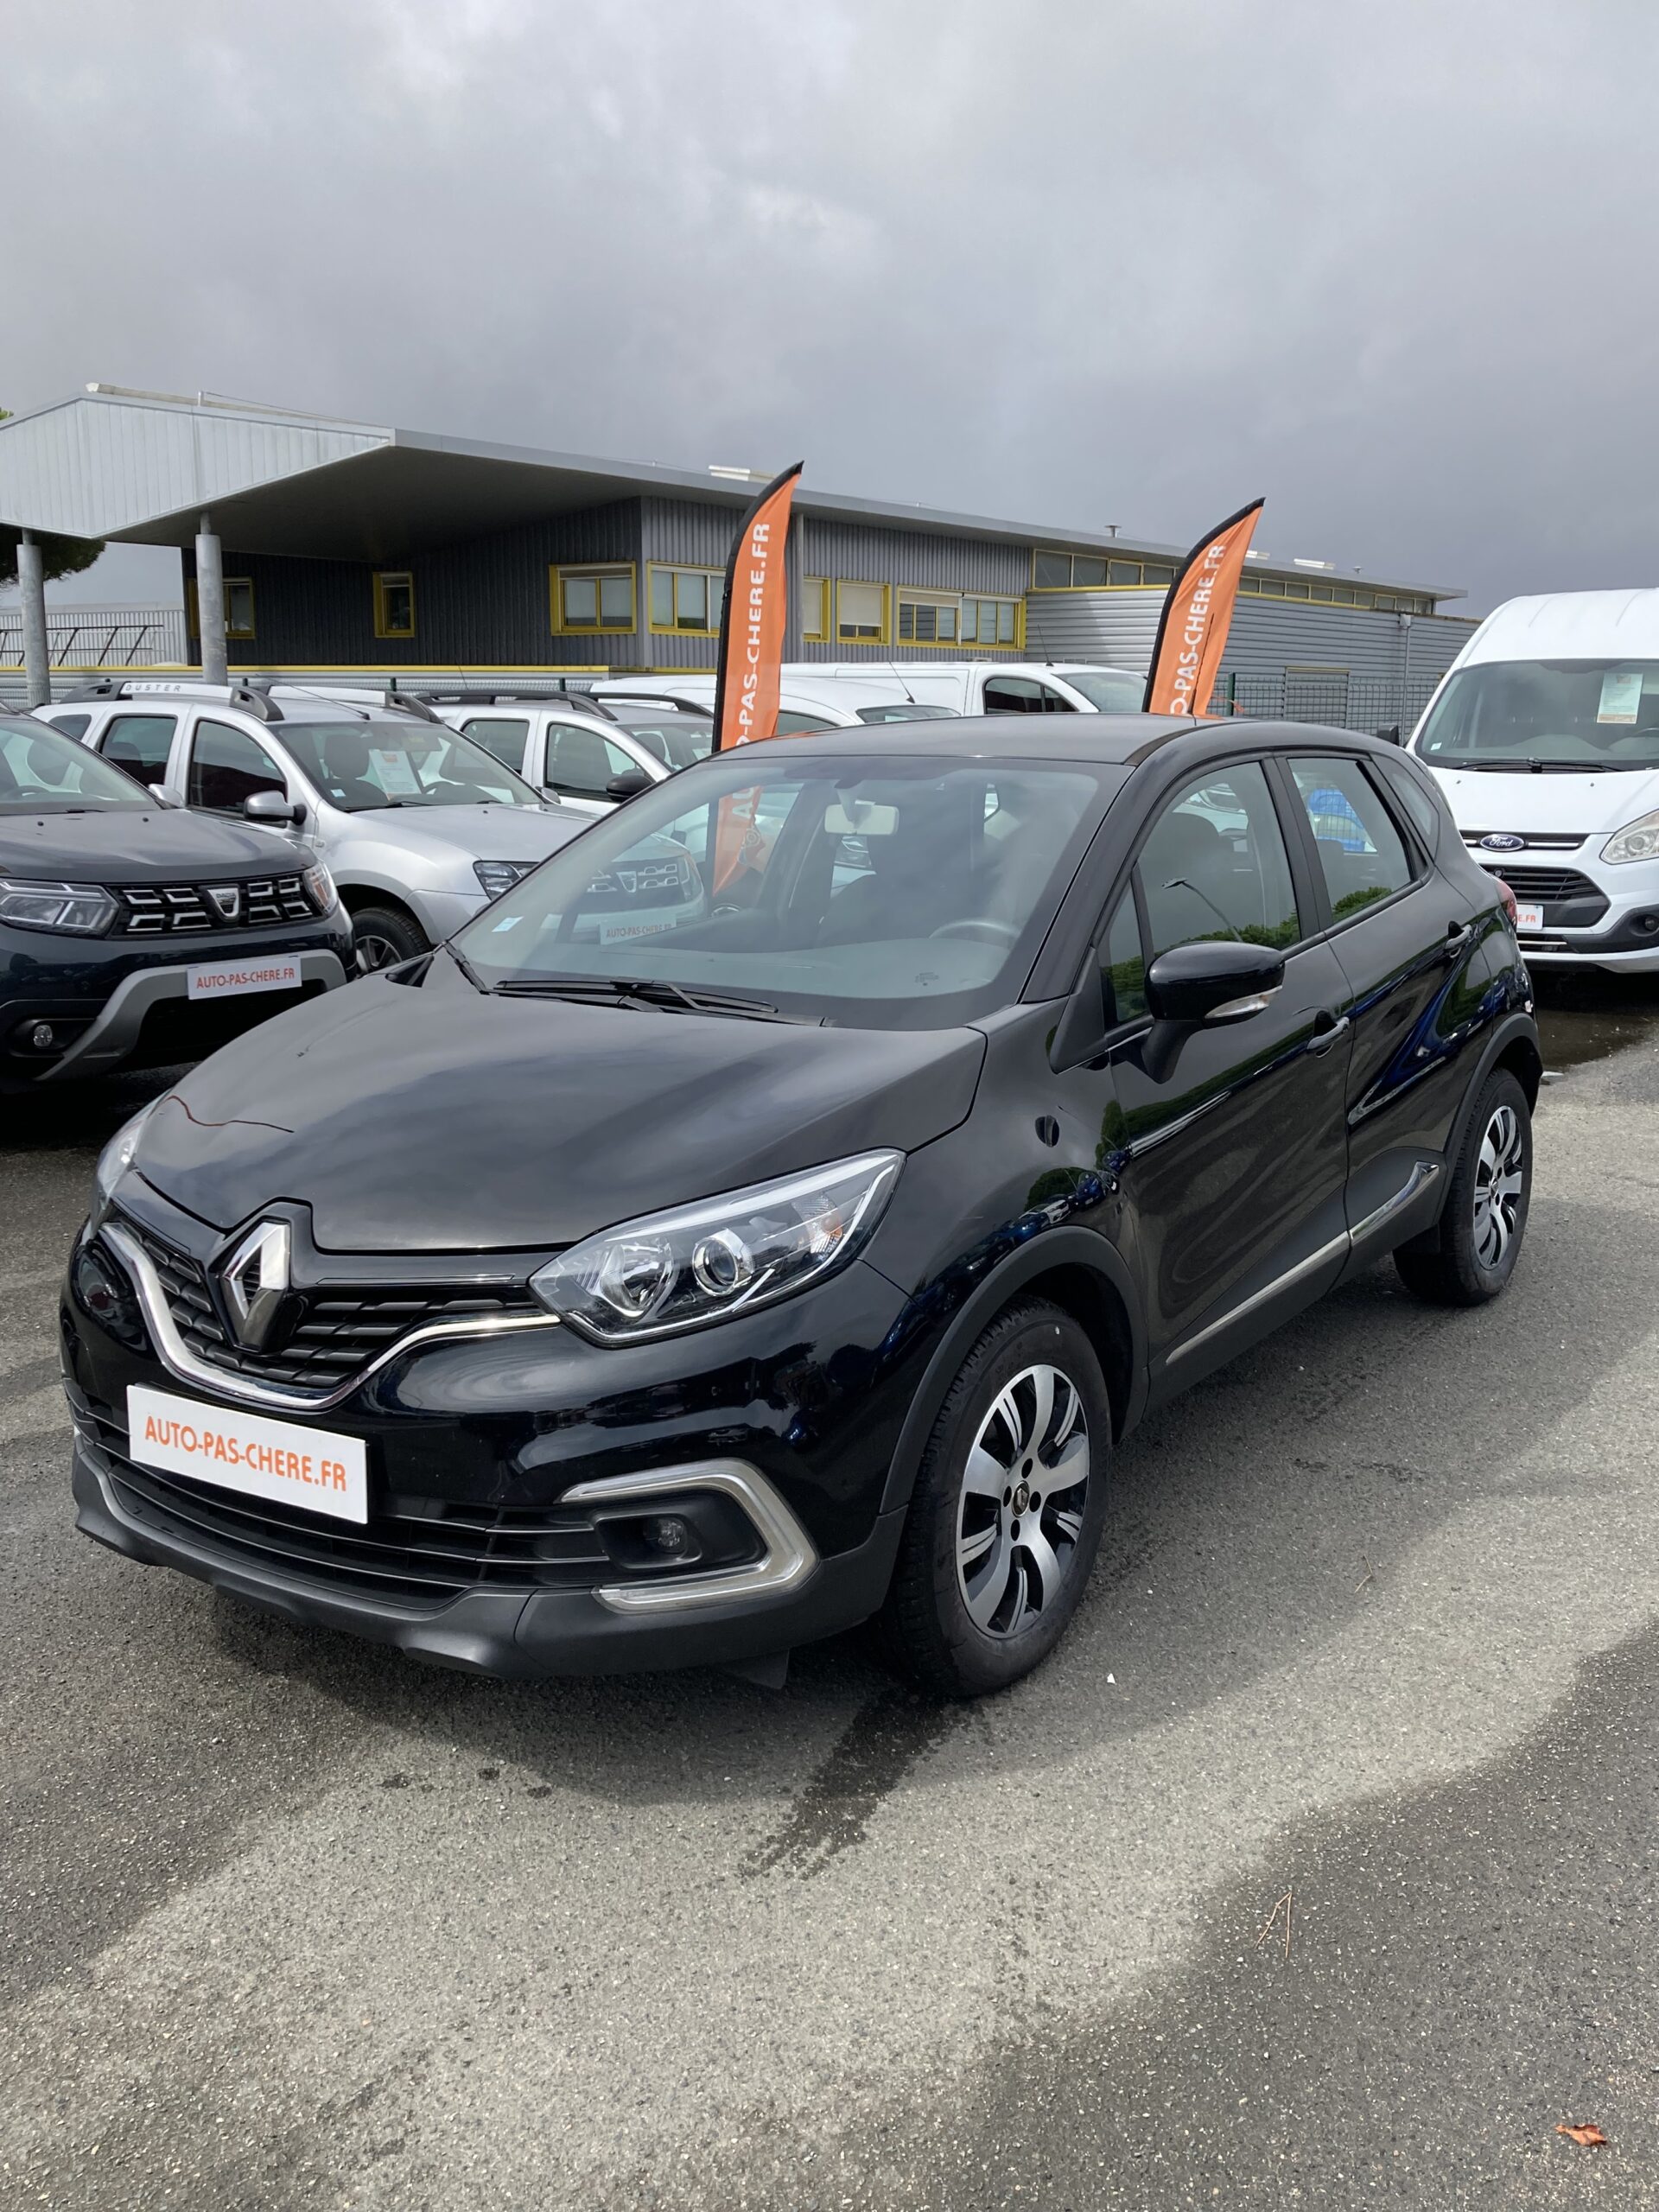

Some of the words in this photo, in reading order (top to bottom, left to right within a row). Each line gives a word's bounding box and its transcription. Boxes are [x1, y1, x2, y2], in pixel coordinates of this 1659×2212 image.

[125, 683, 181, 692] DUSTER
[1489, 834, 1514, 847] Ford
[606, 924, 671, 938] AUTO-PAS-CHEREFR
[196, 968, 295, 988] AUTO-PAS-CHERE.FR
[144, 1415, 347, 1492] AUTO-PAS-CHERE.FR
